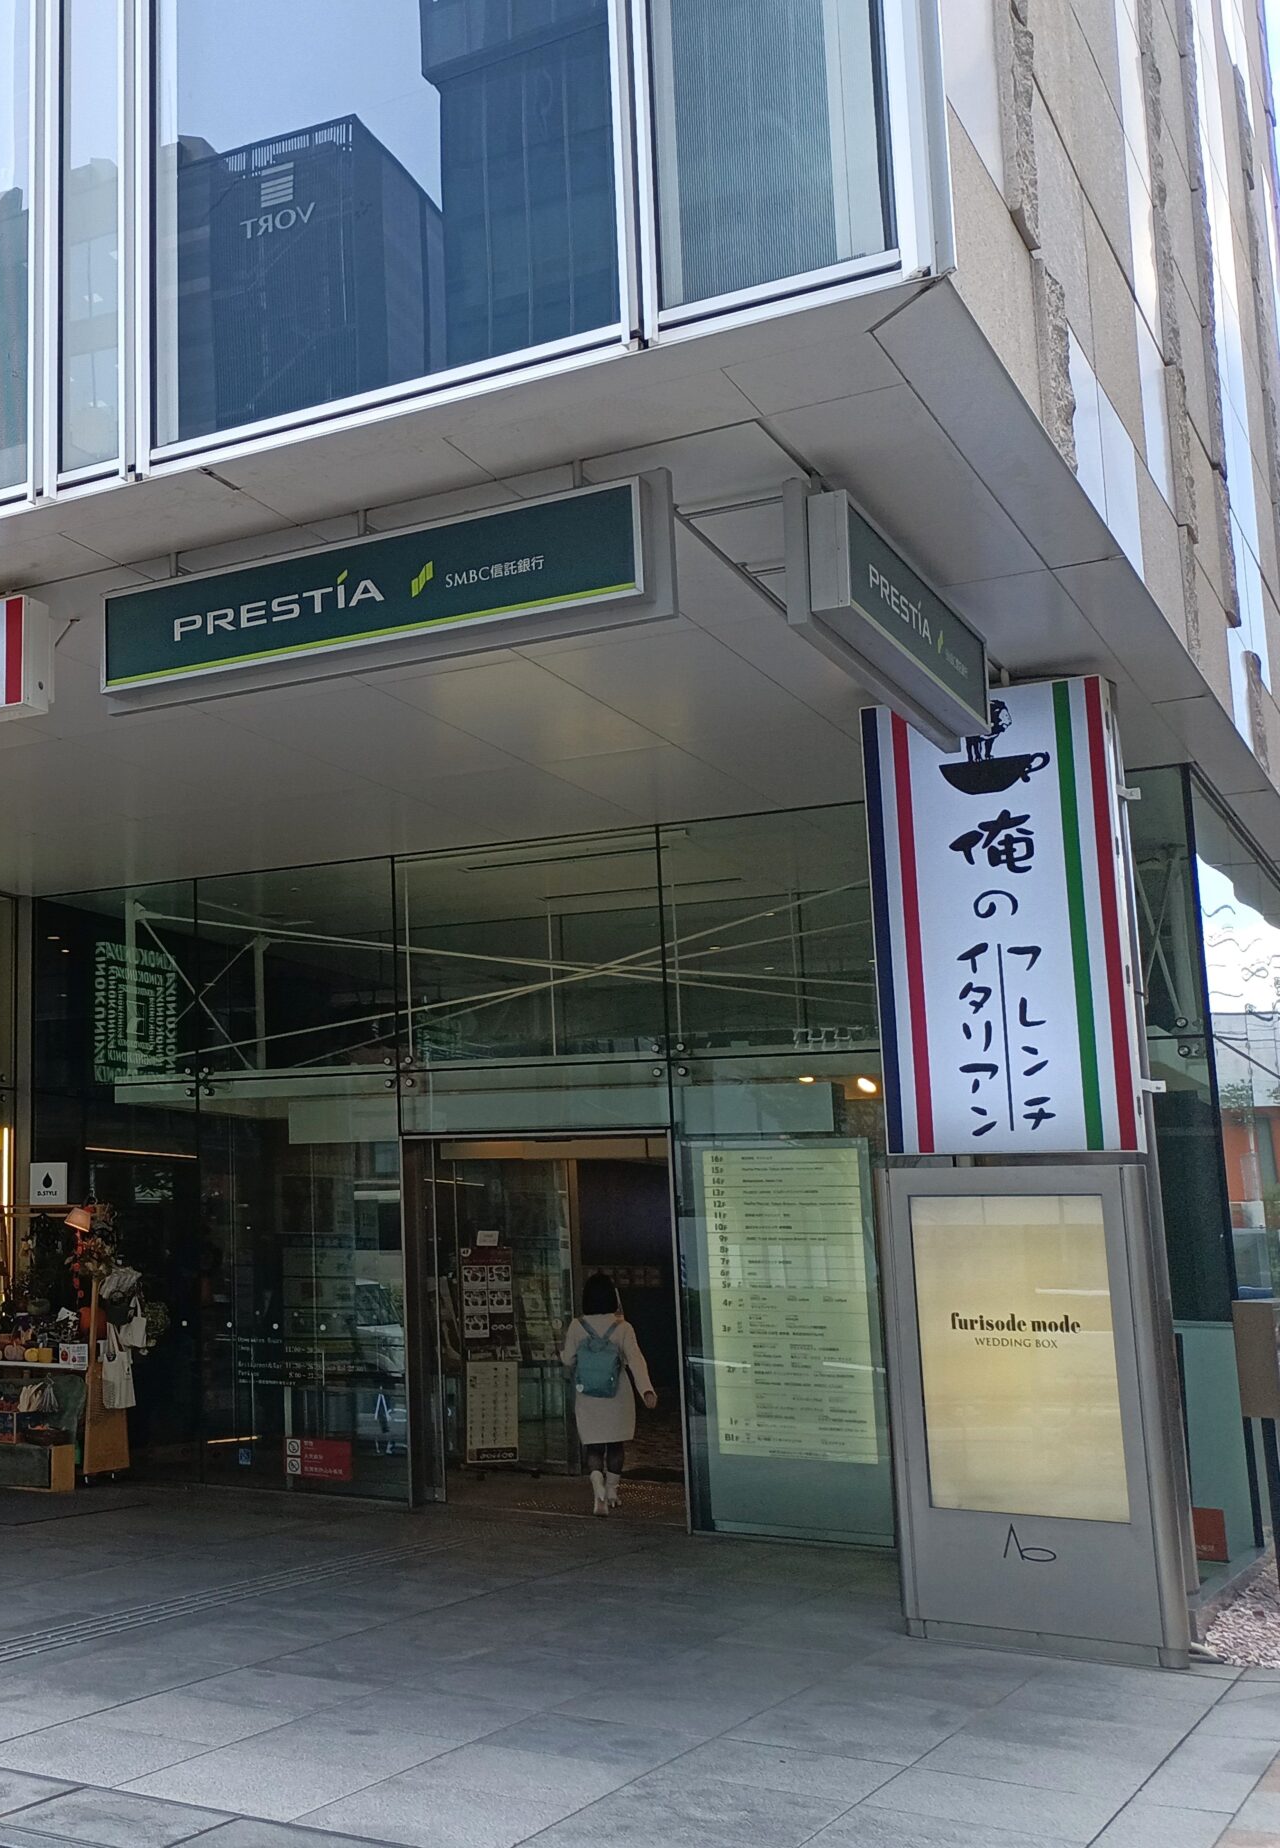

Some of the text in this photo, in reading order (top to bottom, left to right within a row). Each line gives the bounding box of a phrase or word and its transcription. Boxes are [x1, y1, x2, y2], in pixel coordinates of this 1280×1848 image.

[445, 554, 545, 589] SMBC信託銀行
[949, 809, 1037, 919] 俺の
[957, 942, 999, 1137] イタリアン
[1007, 945, 1056, 1130] フレンチ
[951, 1312, 1081, 1334] furisode mode
[974, 1336, 1058, 1349] WEDDING BOX
